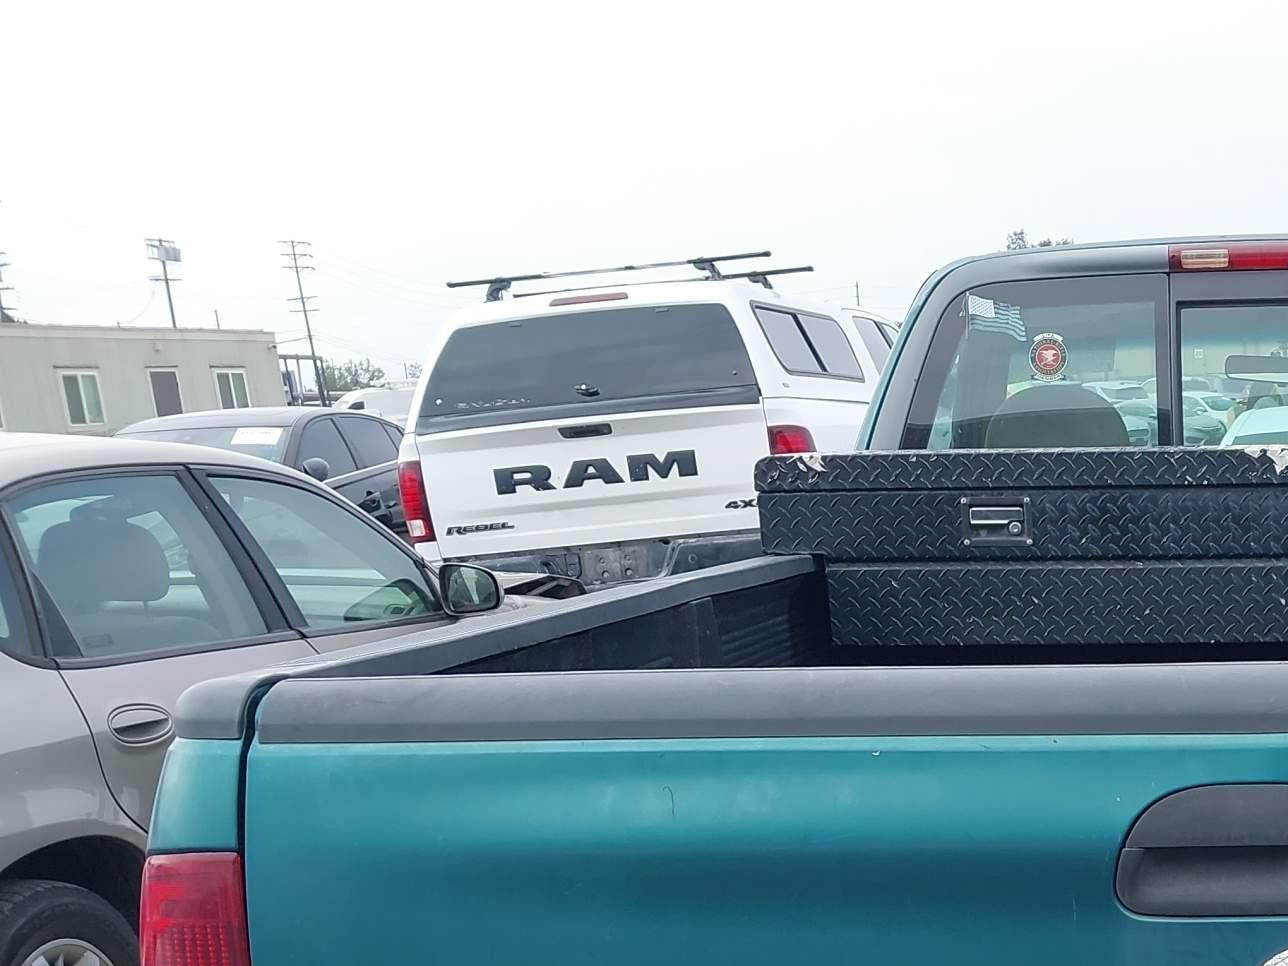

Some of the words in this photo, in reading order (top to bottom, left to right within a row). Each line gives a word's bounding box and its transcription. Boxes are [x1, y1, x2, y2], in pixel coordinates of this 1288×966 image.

[493, 449, 699, 495] RAM
[725, 498, 758, 509] 4X
[446, 522, 515, 536] REBEL
